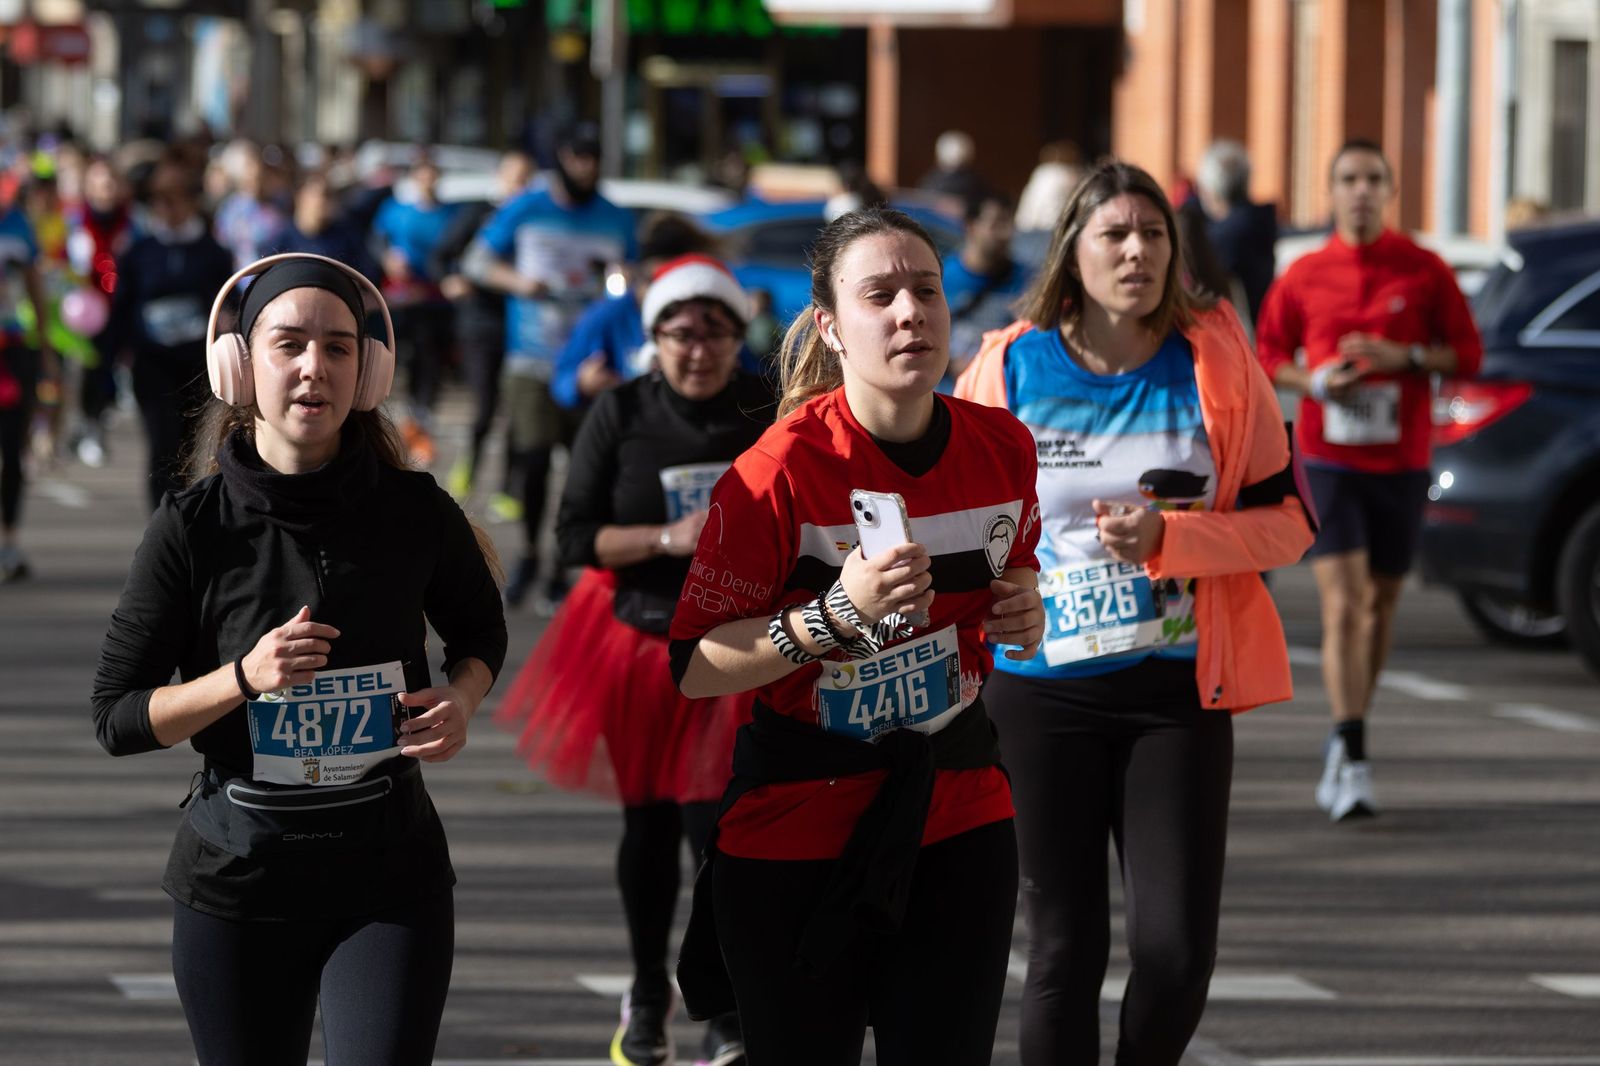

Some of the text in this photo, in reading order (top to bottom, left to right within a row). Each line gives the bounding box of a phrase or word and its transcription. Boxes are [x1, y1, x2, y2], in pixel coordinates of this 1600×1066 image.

[720, 570, 773, 602] Dental
[1054, 579, 1139, 633] 3526
[858, 639, 946, 682] SETEL
[291, 672, 393, 697] SETEL
[847, 669, 929, 731] 4416
[271, 698, 374, 748] 4872
[294, 748, 315, 758] BEA
[282, 831, 343, 841] DINYU
